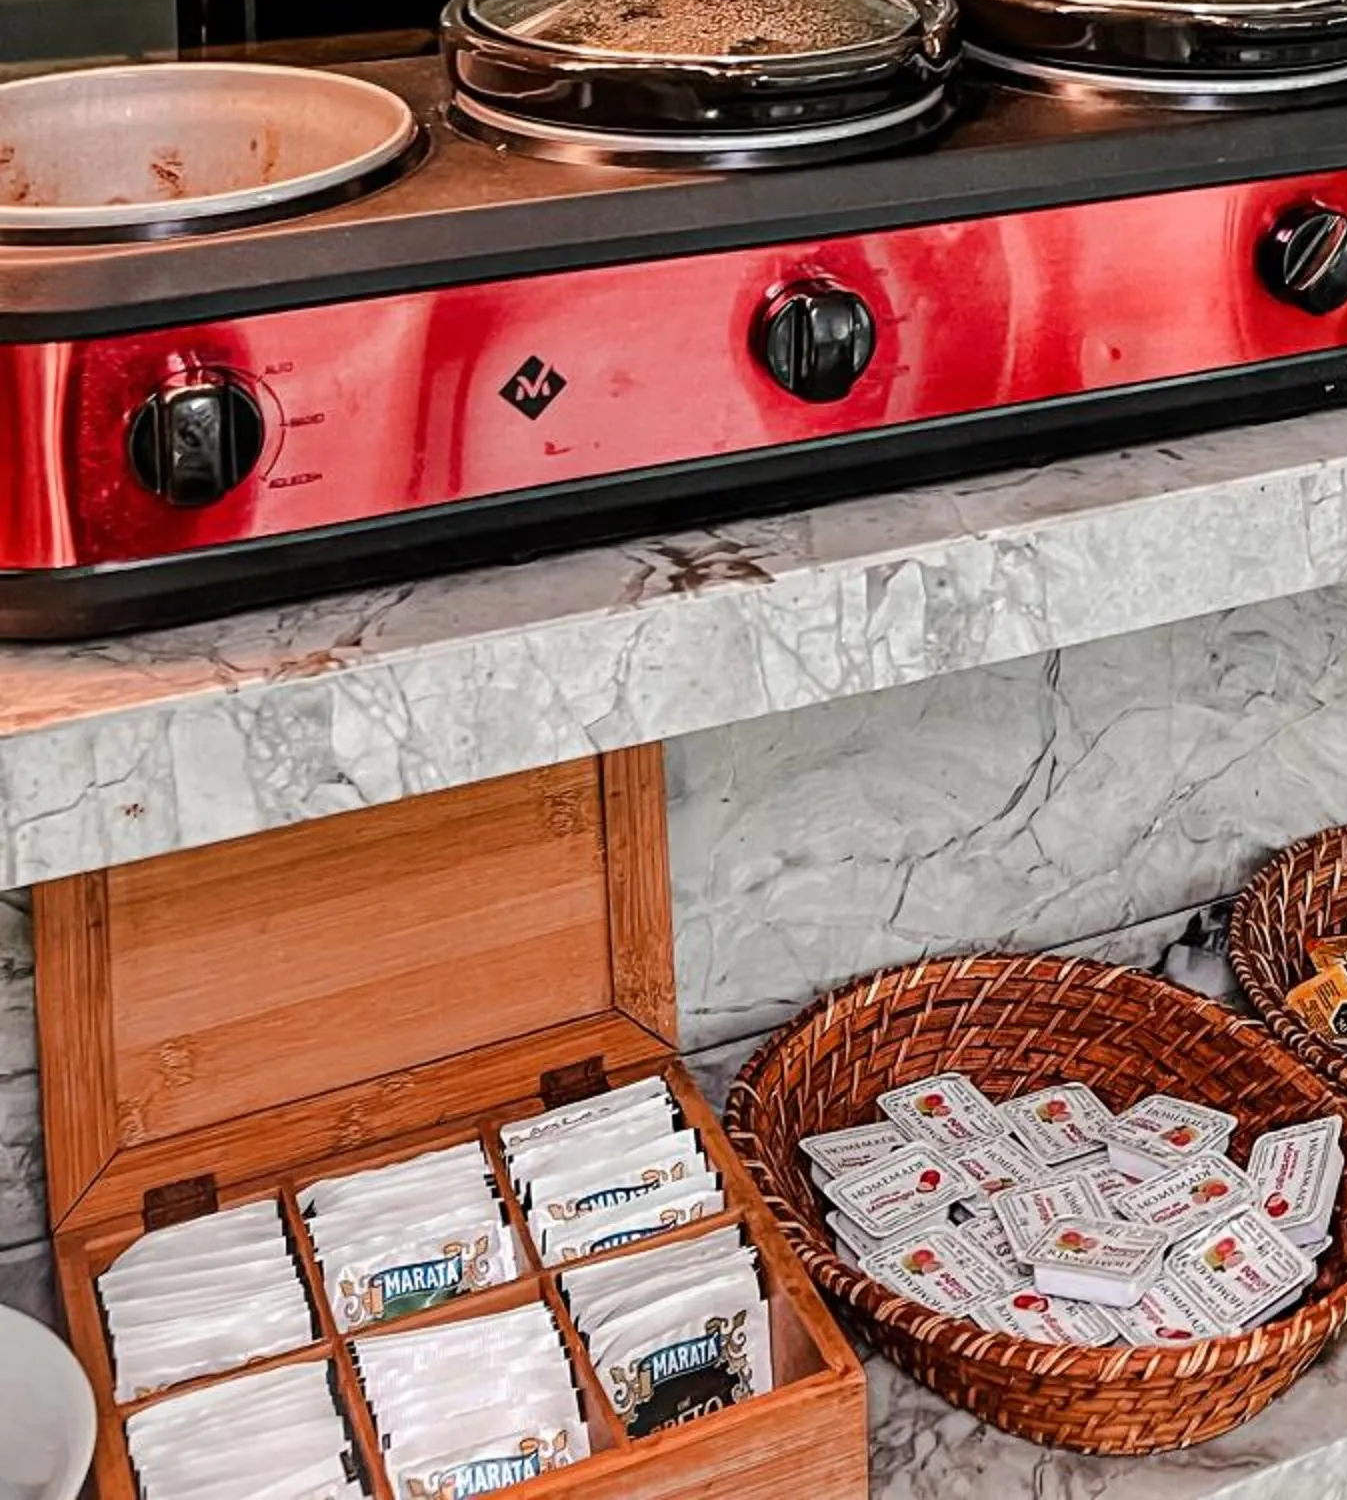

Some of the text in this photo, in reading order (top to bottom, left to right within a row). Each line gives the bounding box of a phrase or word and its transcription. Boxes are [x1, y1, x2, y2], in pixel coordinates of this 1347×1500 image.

[850, 1160, 925, 1201] HOMEMADE
[1136, 1169, 1214, 1211] HOMEMADE
[653, 1331, 720, 1381] MARATÁ
[455, 1452, 538, 1498] MARATÁ
